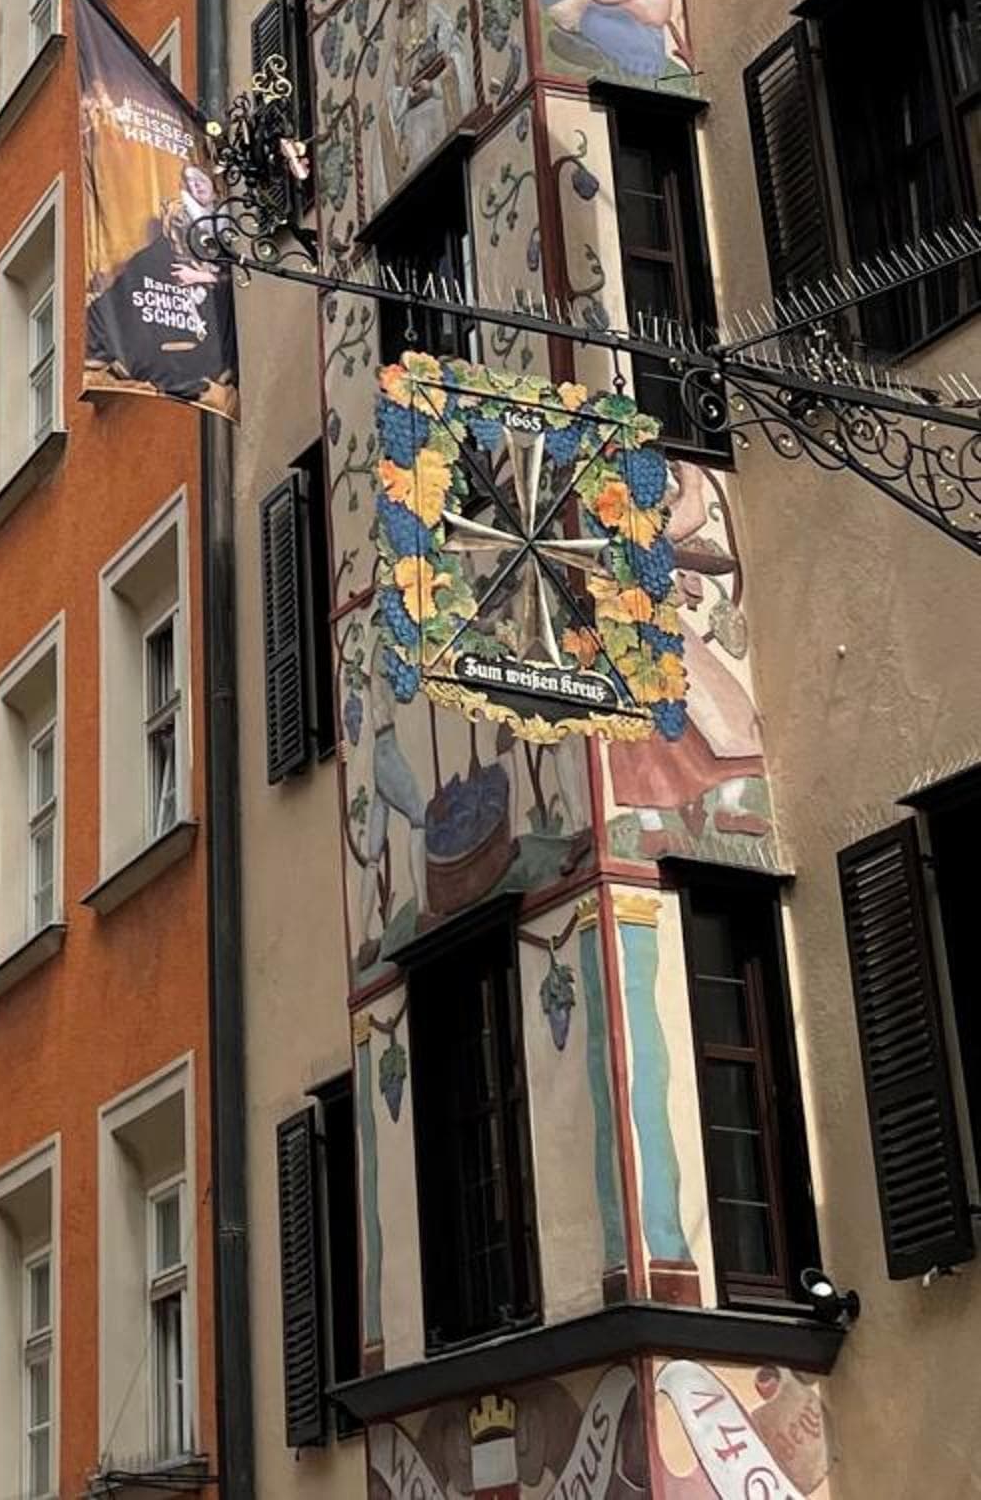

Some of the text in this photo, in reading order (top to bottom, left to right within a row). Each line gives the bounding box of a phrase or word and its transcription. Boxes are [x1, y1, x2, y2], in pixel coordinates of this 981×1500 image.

[116, 107, 194, 147] WEISSES
[124, 123, 189, 161] KREUZ
[132, 291, 196, 313] SCHICK
[142, 307, 208, 335] SCHOCK
[465, 656, 502, 681] Zum
[561, 674, 607, 702] Kreuz
